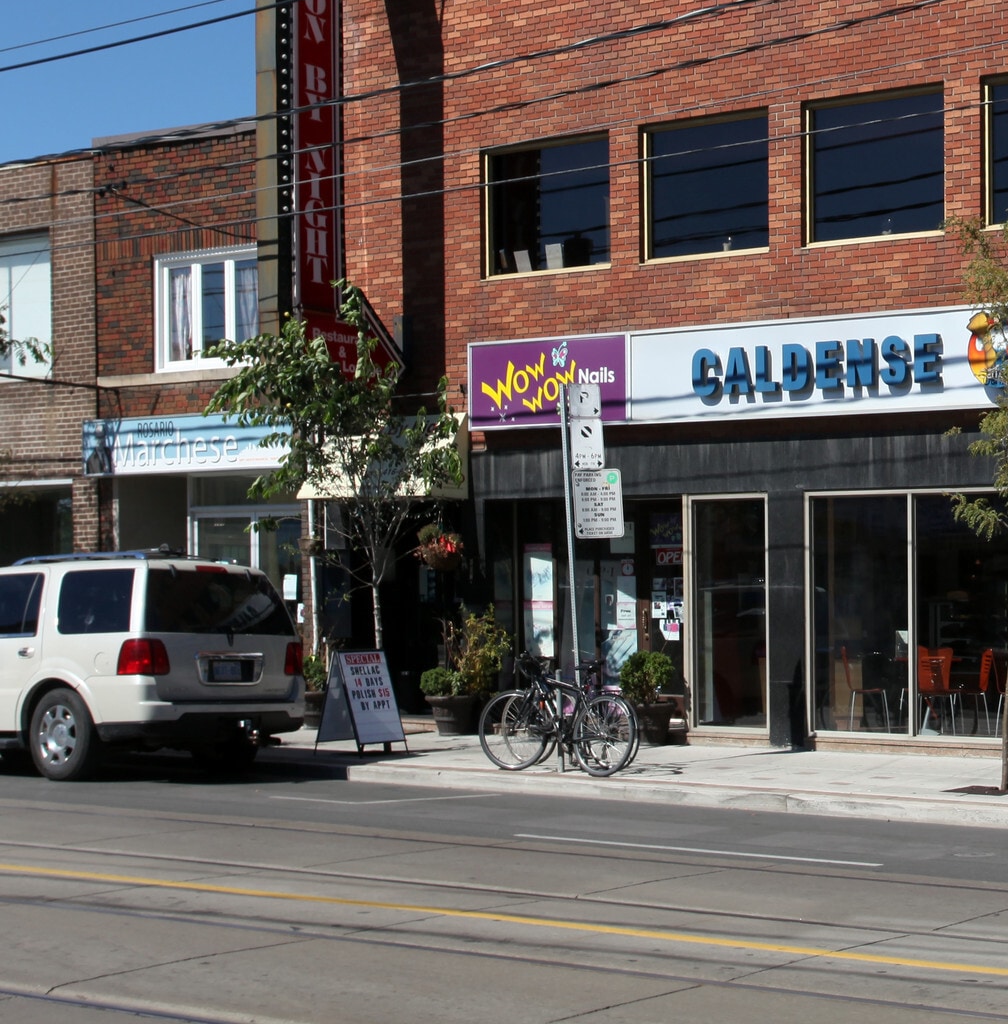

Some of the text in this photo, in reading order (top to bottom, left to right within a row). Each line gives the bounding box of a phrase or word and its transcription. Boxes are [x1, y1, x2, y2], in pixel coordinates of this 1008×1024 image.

[304, 63, 327, 122] BY
[304, 143, 328, 285] NIGHT
[312, 327, 373, 345] Restaur
[339, 345, 347, 359] &
[691, 333, 942, 398] CALDENSE
[481, 352, 546, 410] WOW
[522, 359, 615, 413] WOW Nails
[137, 420, 174, 438] ROSARIO
[113, 427, 239, 469] Marchese
[658, 551, 683, 565] OPE
[345, 654, 382, 665] SPECIAL
[350, 665, 381, 676] SHELLAC
[354, 676, 384, 688] 14 DAYS
[351, 688, 377, 700] POLISH
[360, 699, 390, 711] BY APPT
